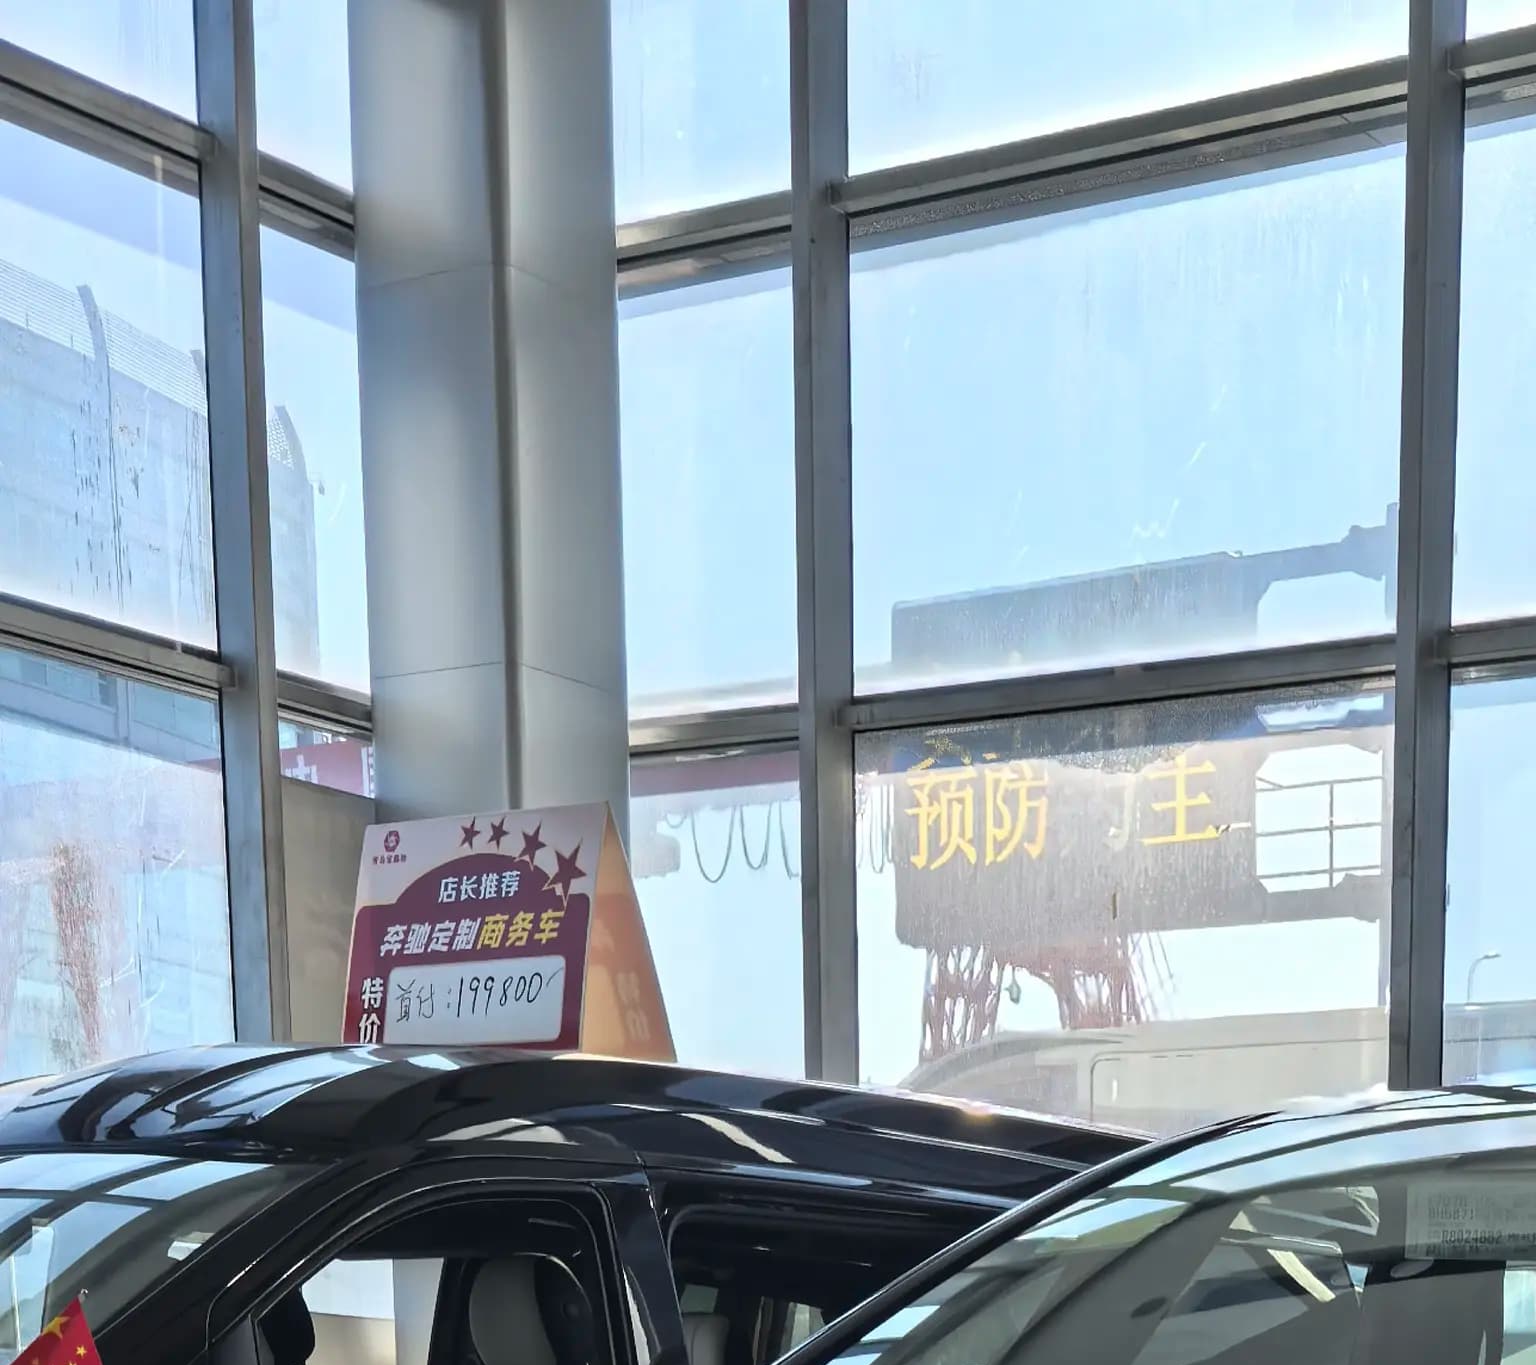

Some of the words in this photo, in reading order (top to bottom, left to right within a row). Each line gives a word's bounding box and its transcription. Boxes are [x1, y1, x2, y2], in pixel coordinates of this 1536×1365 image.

[438, 870, 521, 903] 店长推荐
[380, 908, 565, 957] 奔驰定制商务车
[359, 977, 385, 1043] 特价
